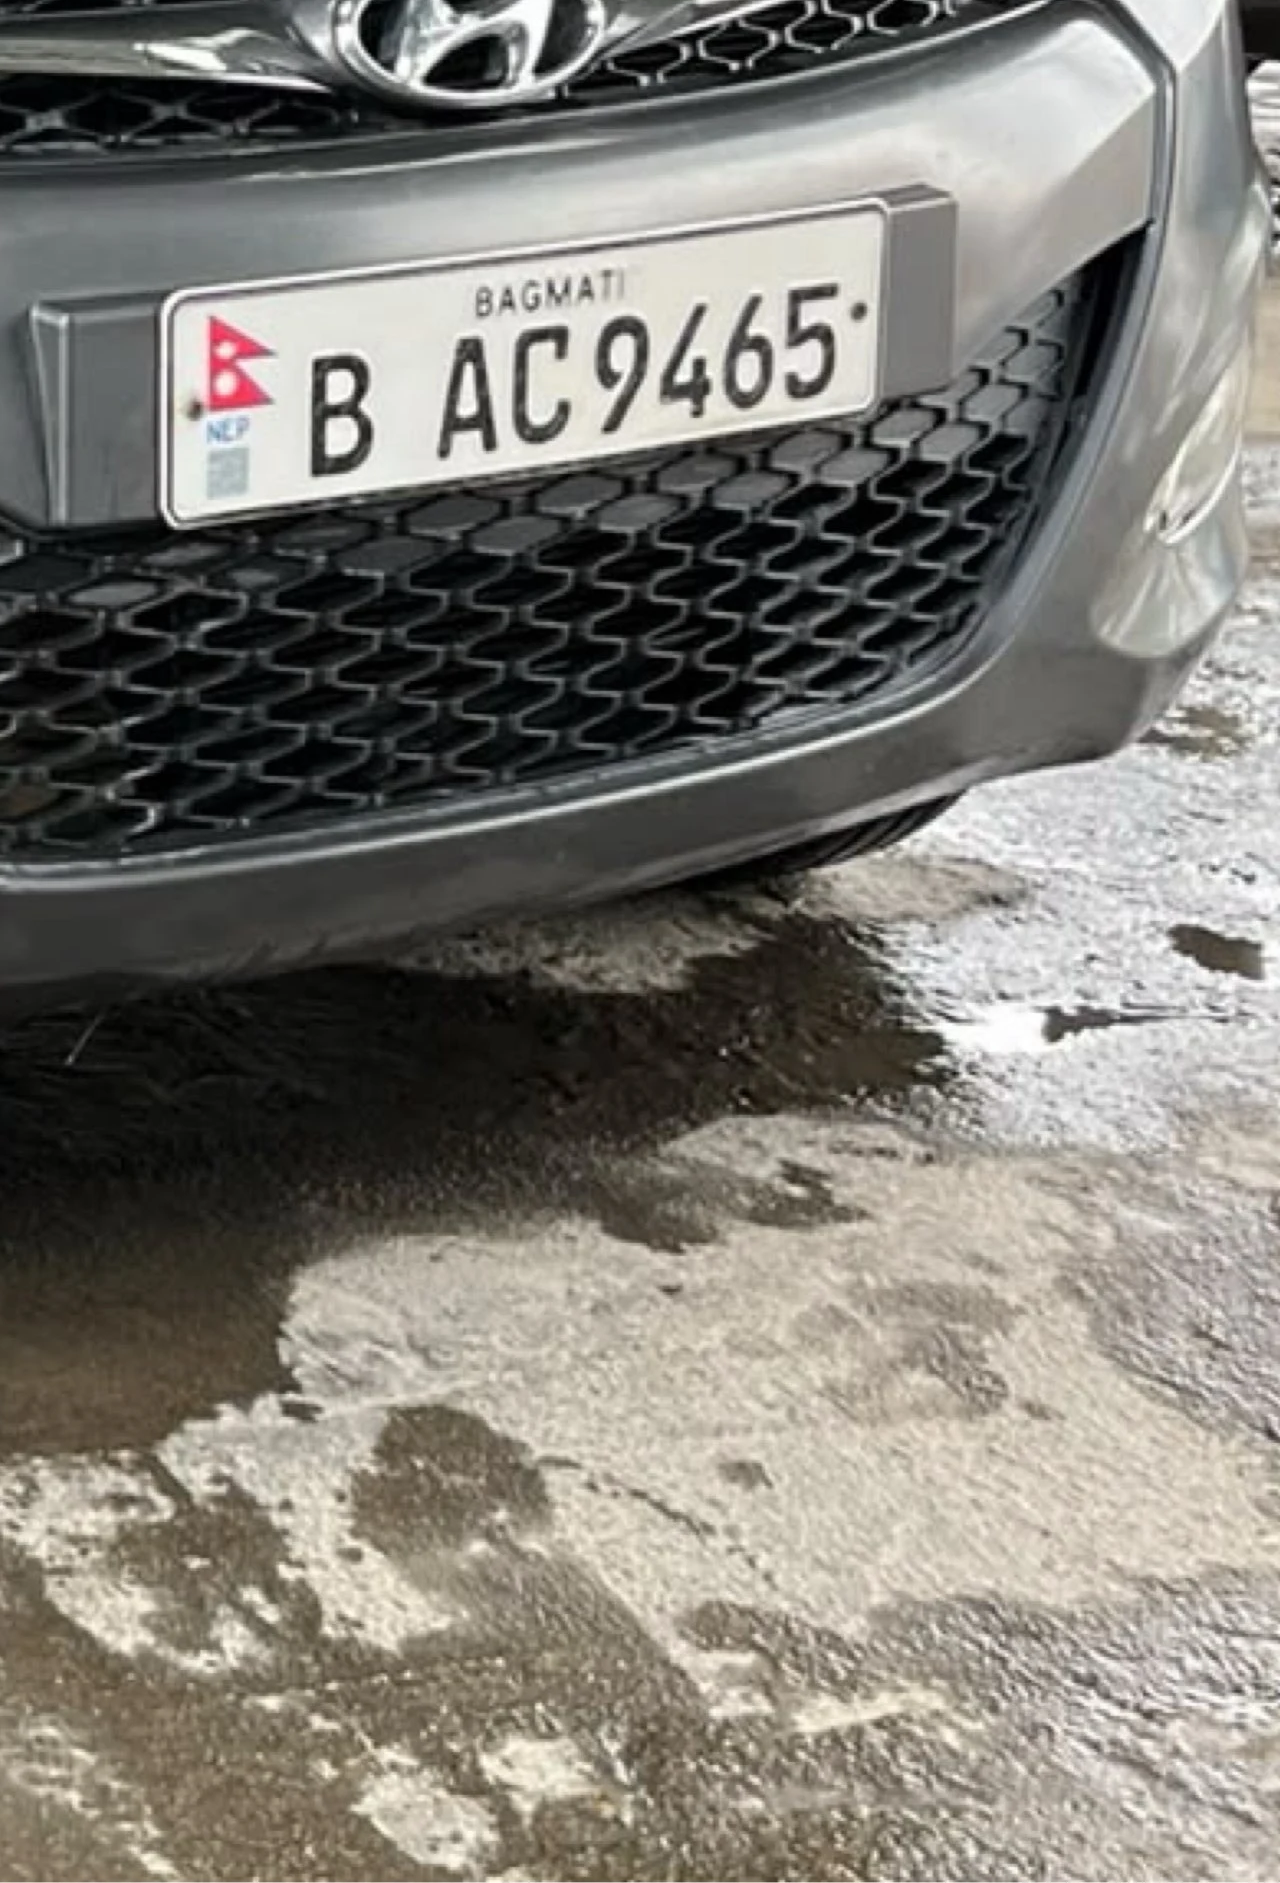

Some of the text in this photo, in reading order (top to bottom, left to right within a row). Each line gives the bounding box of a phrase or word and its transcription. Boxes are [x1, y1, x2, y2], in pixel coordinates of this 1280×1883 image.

[474, 270, 625, 317] BAGMATI
[206, 416, 249, 445] NEP
[311, 353, 375, 478] B
